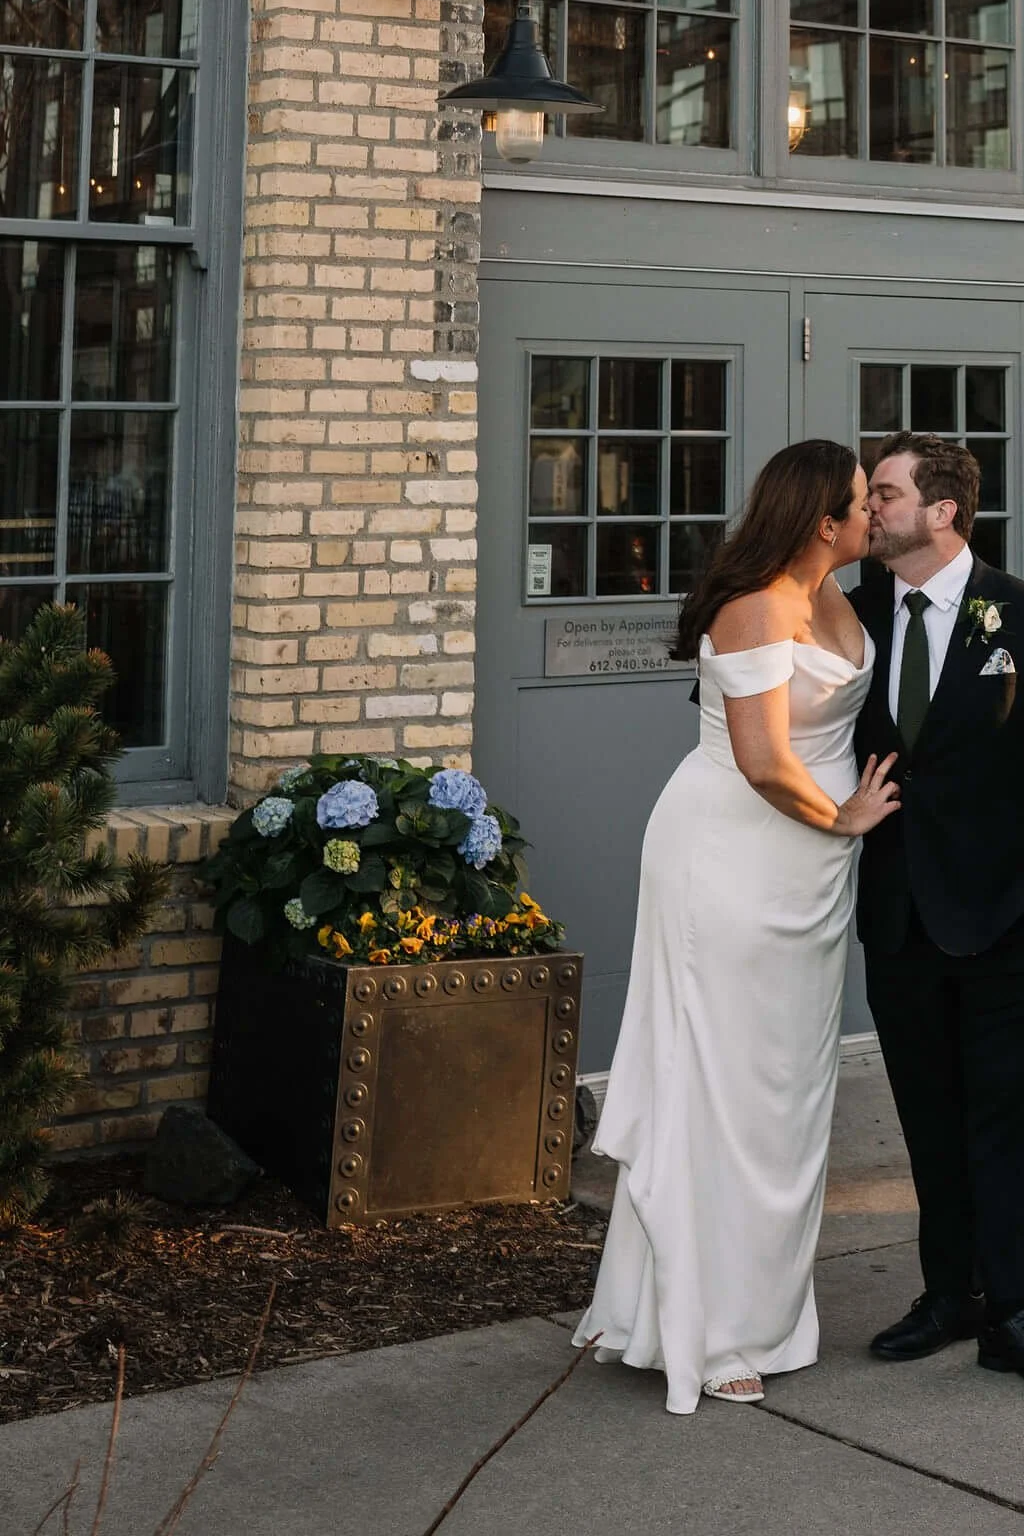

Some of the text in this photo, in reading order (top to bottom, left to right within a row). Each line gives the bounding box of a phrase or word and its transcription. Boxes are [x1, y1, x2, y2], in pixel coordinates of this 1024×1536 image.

[564, 618, 677, 636] Open by Appointm
[556, 638, 571, 648] For
[573, 637, 613, 648] deliveries
[608, 646, 651, 657] please call
[589, 657, 670, 672] 612.940.9647
